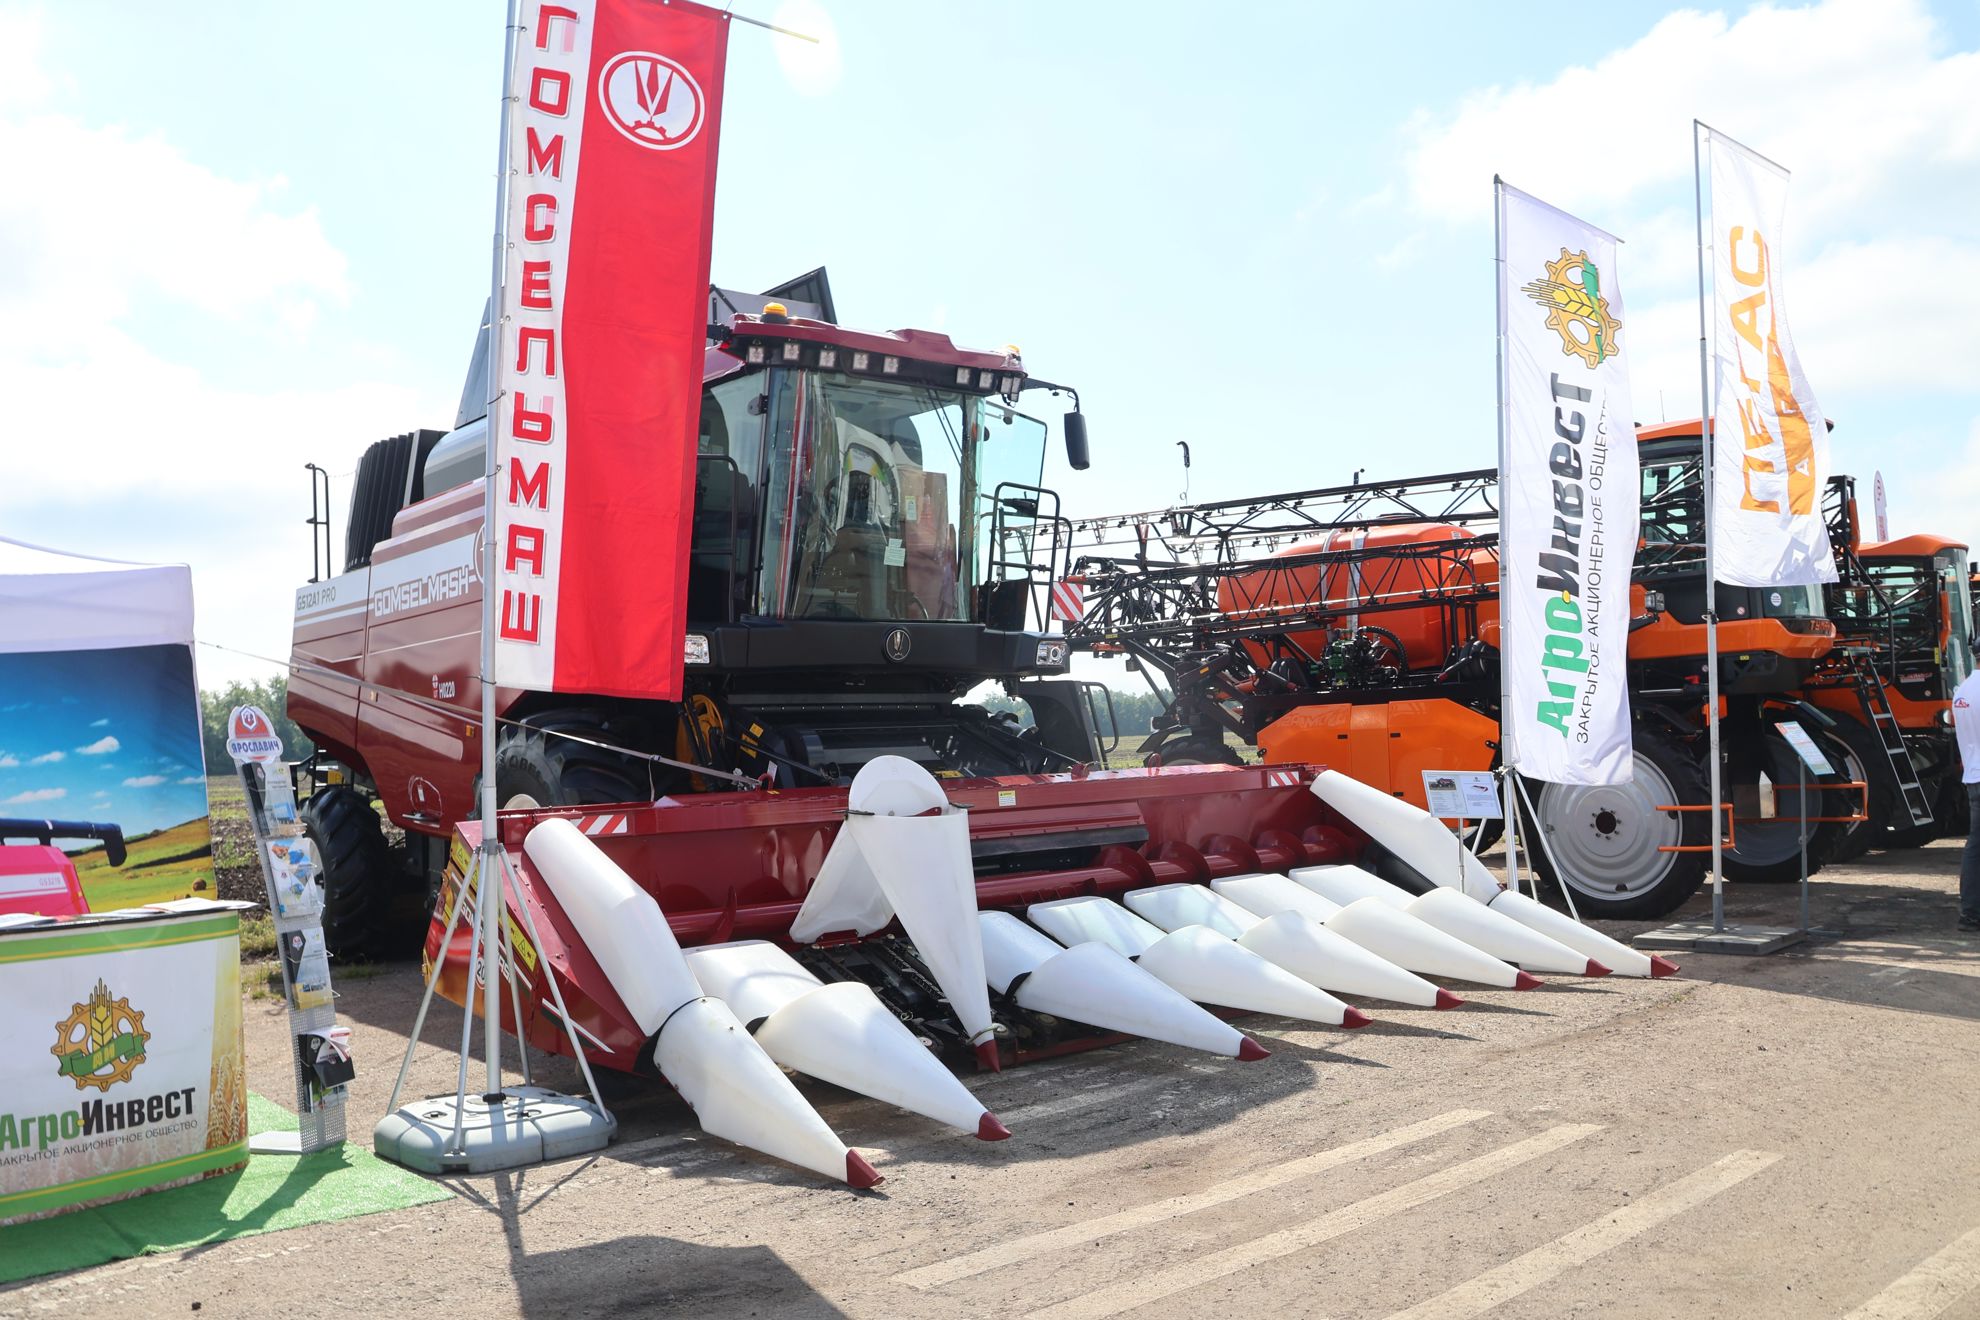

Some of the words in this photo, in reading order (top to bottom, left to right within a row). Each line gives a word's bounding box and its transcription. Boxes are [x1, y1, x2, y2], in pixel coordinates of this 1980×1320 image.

[499, 4, 580, 644] ГОМСЕЛЬМАШ
[1589, 387, 1608, 491] ОБЩЕС
[321, 586, 337, 605] PRO
[374, 564, 470, 617] GOMSELMASH
[1587, 495, 1604, 637] АКЦИОНЕРНОЕ
[1576, 643, 1600, 744] ЗАКРЫТОЕ
[231, 740, 280, 754] ЯРОСЛАВИЧ
[63, 1132, 143, 1155] АКЦИОНЕРНОЕ
[145, 1119, 198, 1140] ОБЩЕСТВО
